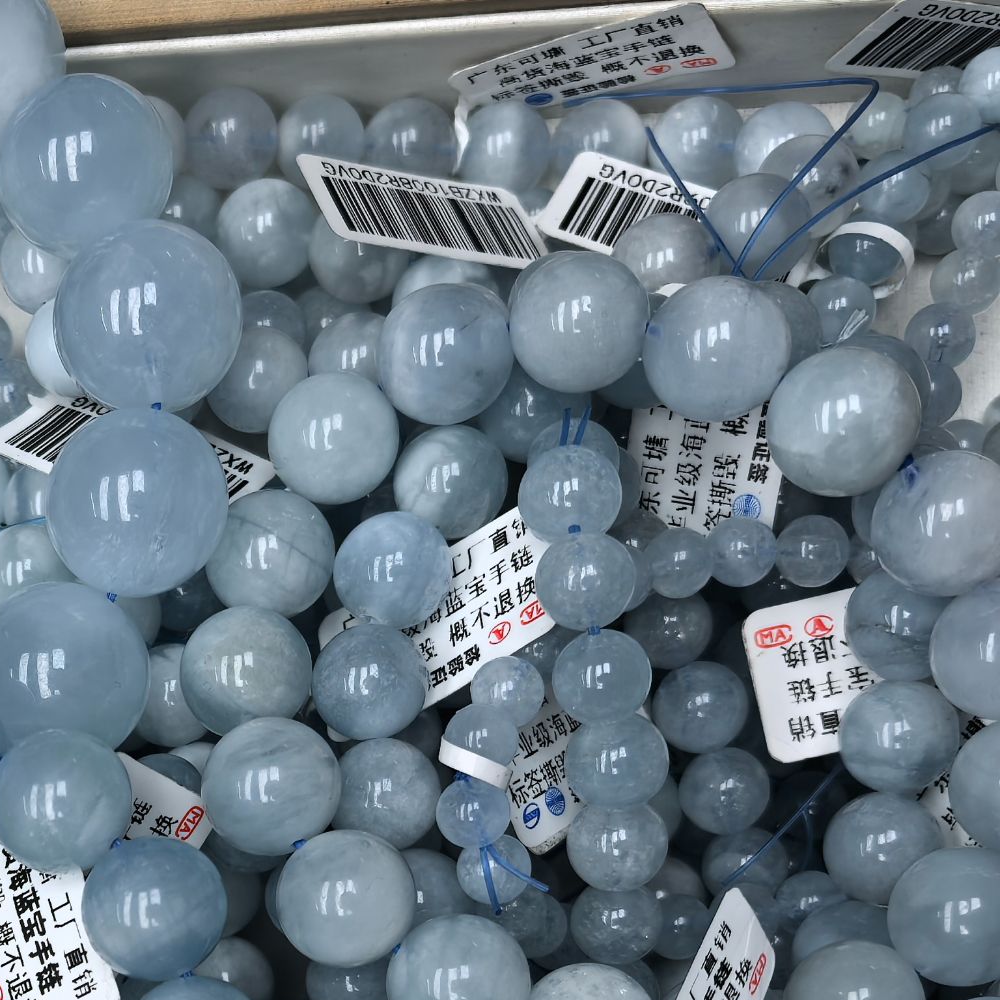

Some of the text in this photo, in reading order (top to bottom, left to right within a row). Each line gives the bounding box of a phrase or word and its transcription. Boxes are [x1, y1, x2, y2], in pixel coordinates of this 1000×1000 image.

[468, 15, 684, 84] 广东可塘 工厂直销
[601, 45, 704, 73] 概不退换
[789, 710, 841, 742] 直销
[48, 892, 96, 999] 工厂直销
